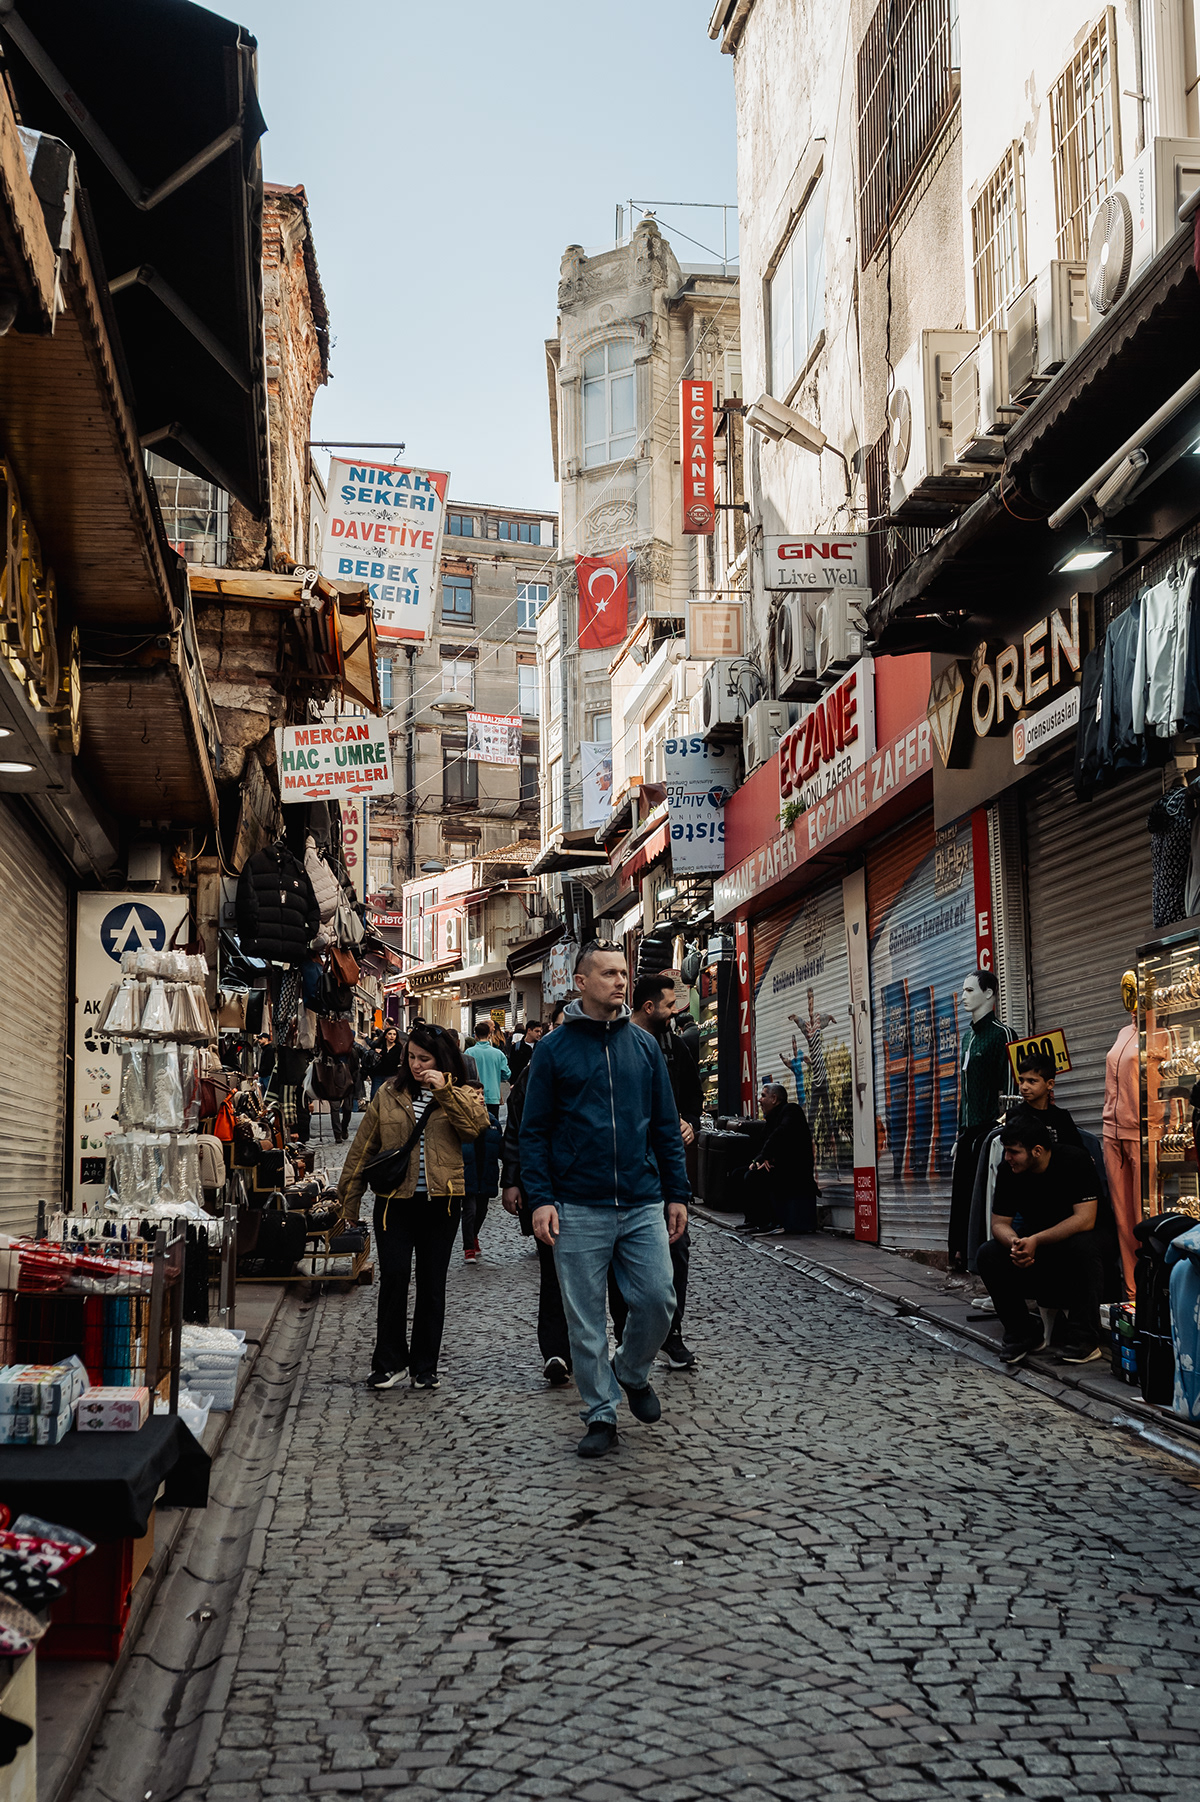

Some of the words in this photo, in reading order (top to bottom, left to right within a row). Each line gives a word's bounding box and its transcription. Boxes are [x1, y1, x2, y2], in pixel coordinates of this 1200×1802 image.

[691, 386, 706, 498] ECZANE
[340, 484, 435, 512] ŞEKERİ
[330, 517, 434, 550] DAVETİYE
[777, 543, 853, 560] GNC
[338, 557, 419, 584] BEBEK
[778, 568, 818, 585] Live
[822, 567, 859, 585] Well
[368, 582, 420, 606] KERİ
[971, 592, 1080, 737] ÖREN
[1027, 696, 1077, 744] orensustaslari
[294, 724, 370, 747] MERCAN
[780, 671, 860, 799] ECZANE
[282, 748, 320, 772] HAC
[334, 742, 387, 765] UMRE
[284, 765, 389, 789] MALZEMELERİ
[825, 755, 852, 794] ZAFER
[758, 829, 797, 886] ZAFER
[808, 769, 868, 851] ECZANE
[871, 719, 931, 804] ZAFER
[84, 1000, 101, 1015] AK
[1056, 1051, 1068, 1063] TL
